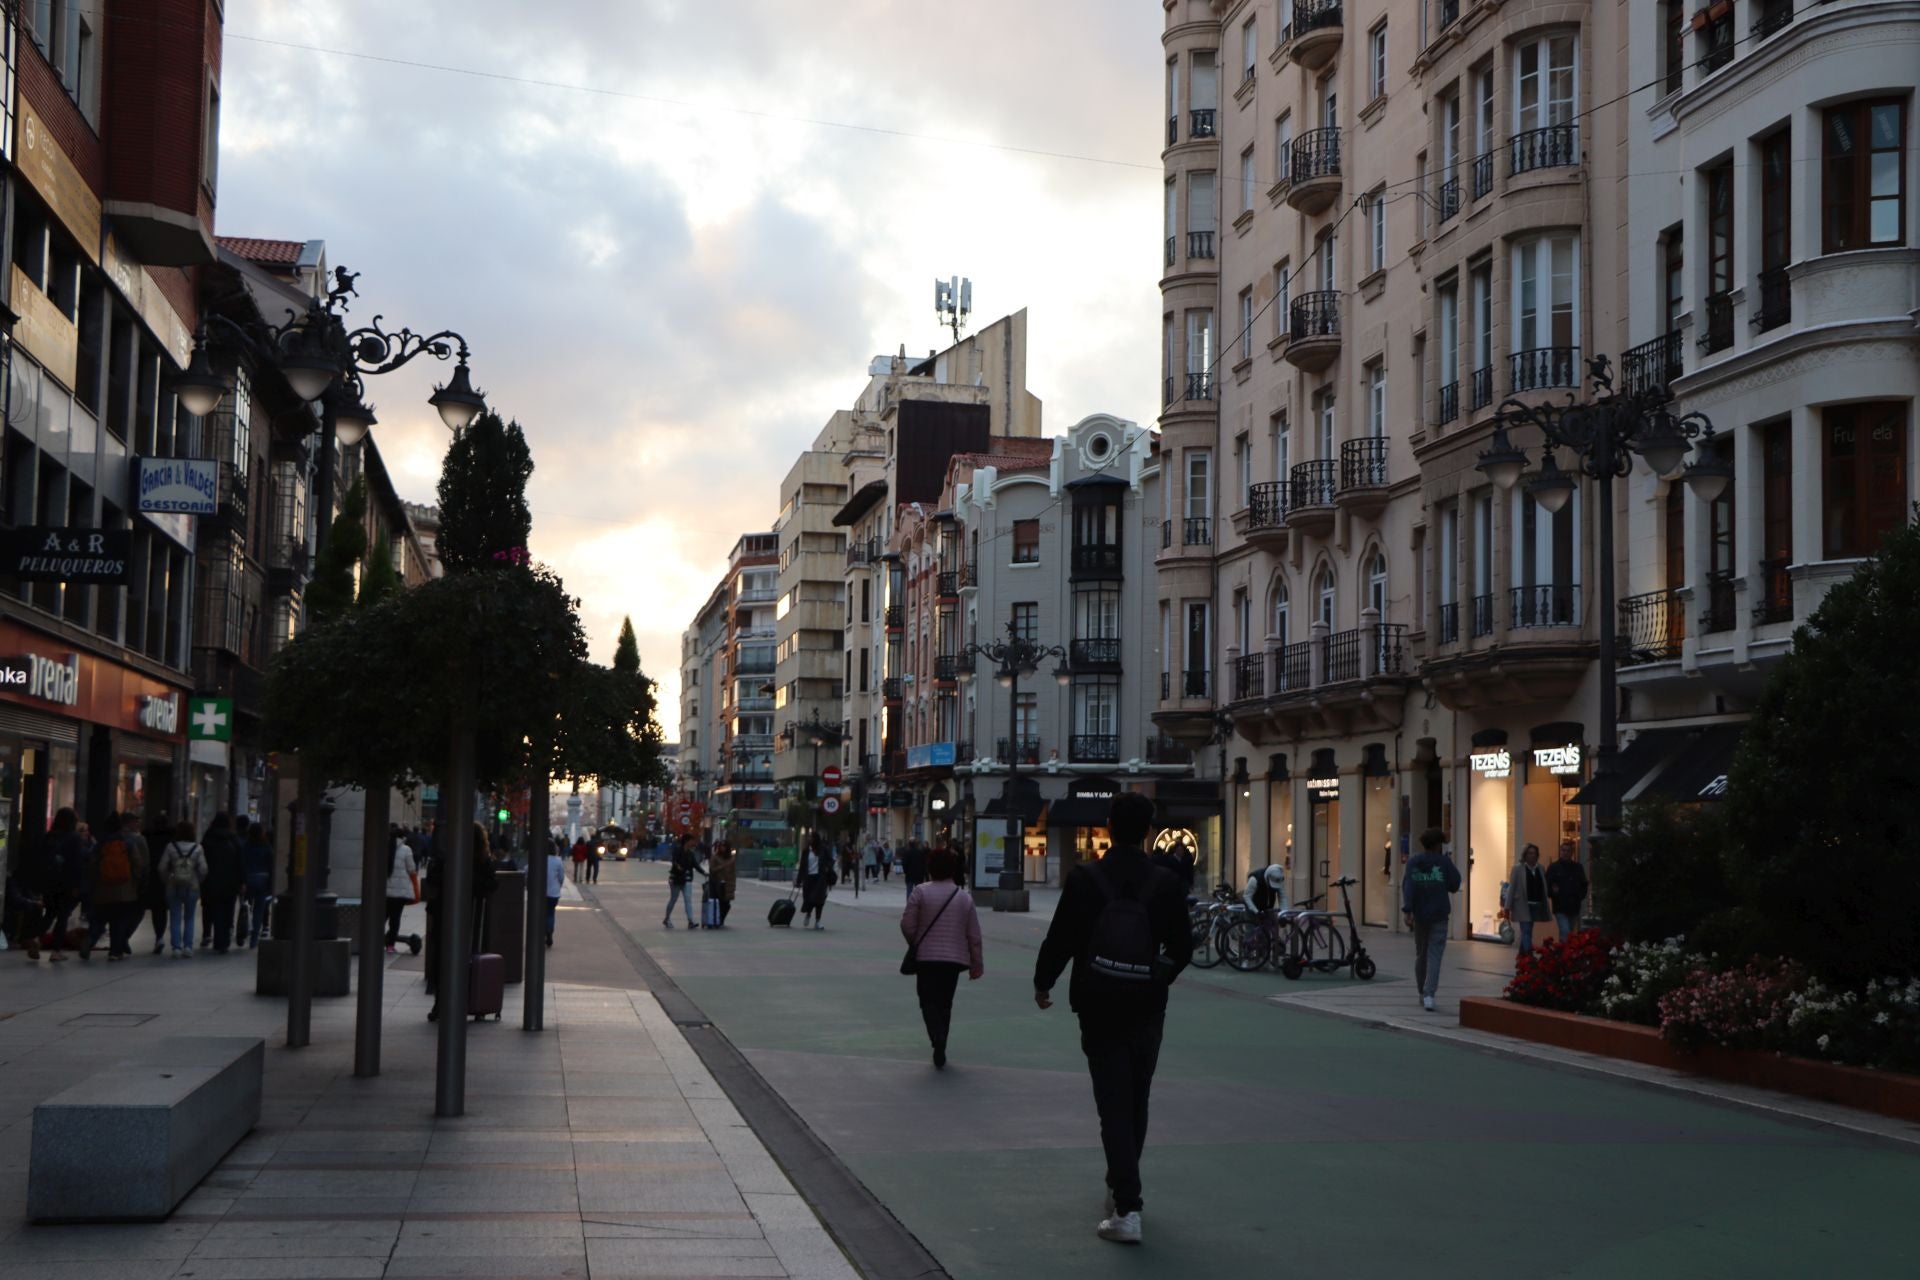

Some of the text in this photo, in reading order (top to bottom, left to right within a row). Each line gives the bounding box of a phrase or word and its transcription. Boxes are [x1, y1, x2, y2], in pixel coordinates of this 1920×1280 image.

[142, 499, 213, 511] GESTORÍA
[42, 532, 104, 554] A & R
[18, 556, 125, 576] PELUQUEROS
[145, 692, 179, 734] arenal
[1470, 748, 1510, 770] TEZENIS
[1534, 742, 1580, 766] TEZENIS
[826, 801, 836, 809] 10
